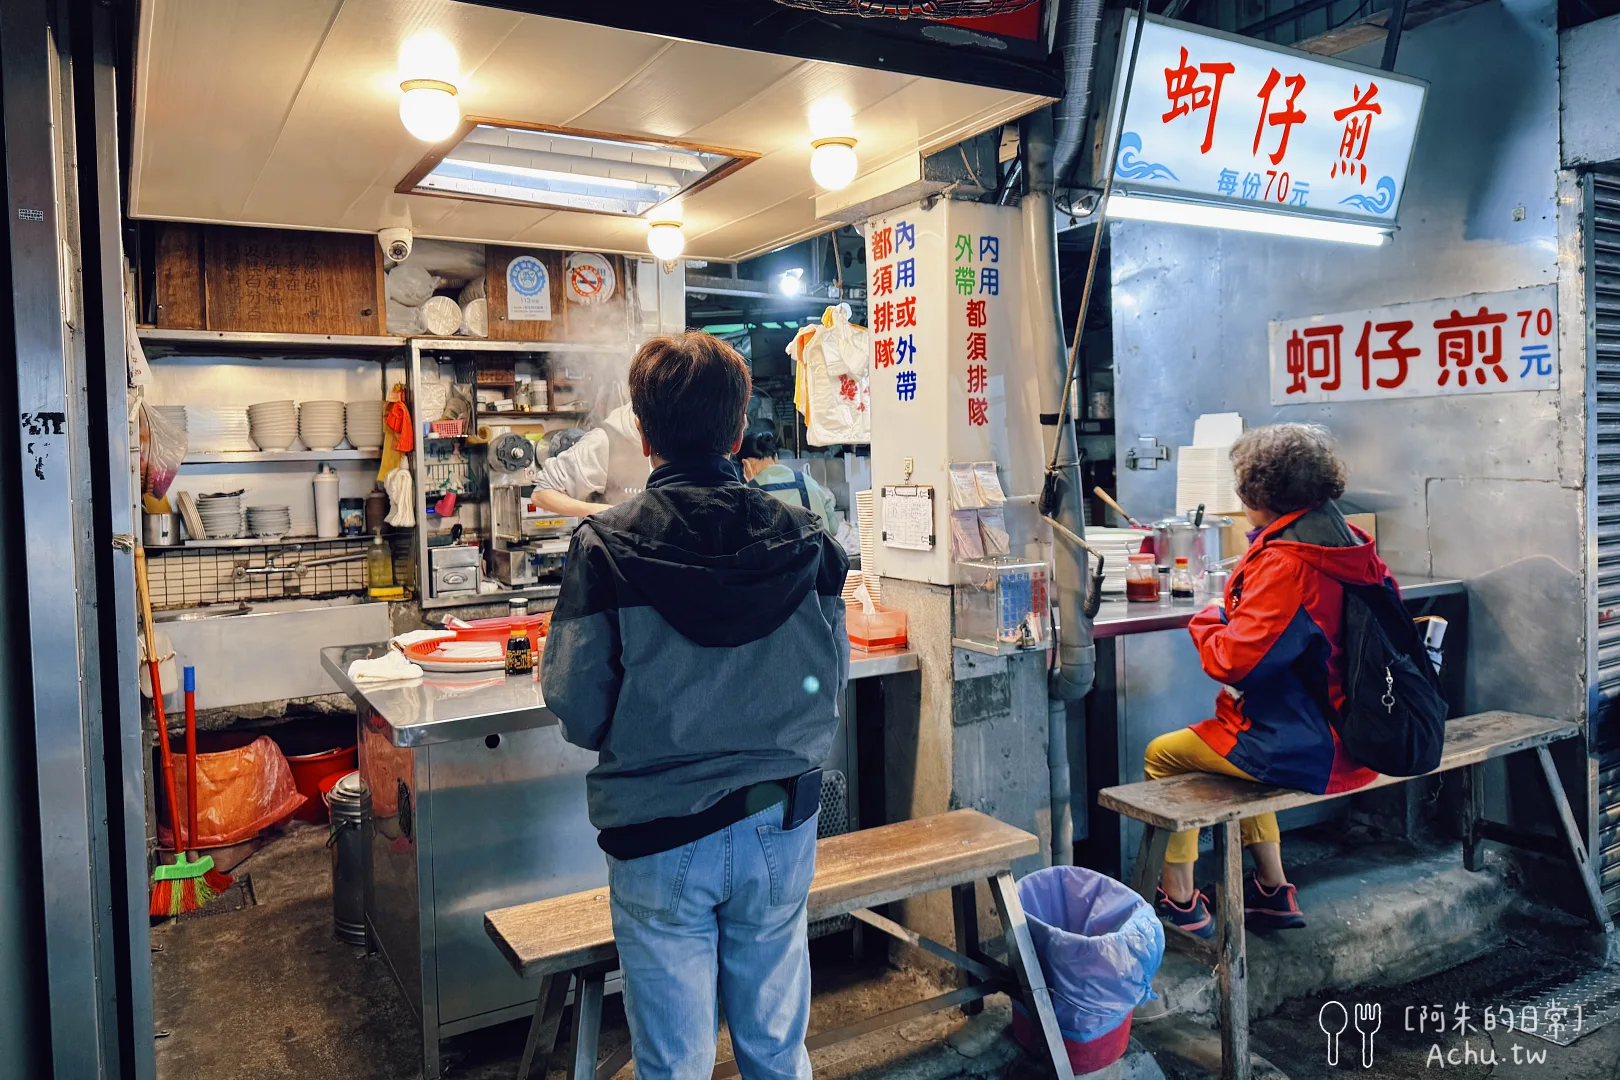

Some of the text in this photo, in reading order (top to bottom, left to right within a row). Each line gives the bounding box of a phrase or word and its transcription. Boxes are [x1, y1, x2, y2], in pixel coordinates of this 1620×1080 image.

[1161, 45, 1382, 185] 蚵仔煎
[1218, 168, 1310, 207] 每份70元
[871, 226, 895, 370] 都須排隊
[955, 233, 976, 296] 外帶
[1285, 306, 1508, 396] 蚵仔煎
[1517, 308, 1552, 339] 70
[1519, 344, 1552, 378] 元
[966, 299, 989, 427] 都須排隊
